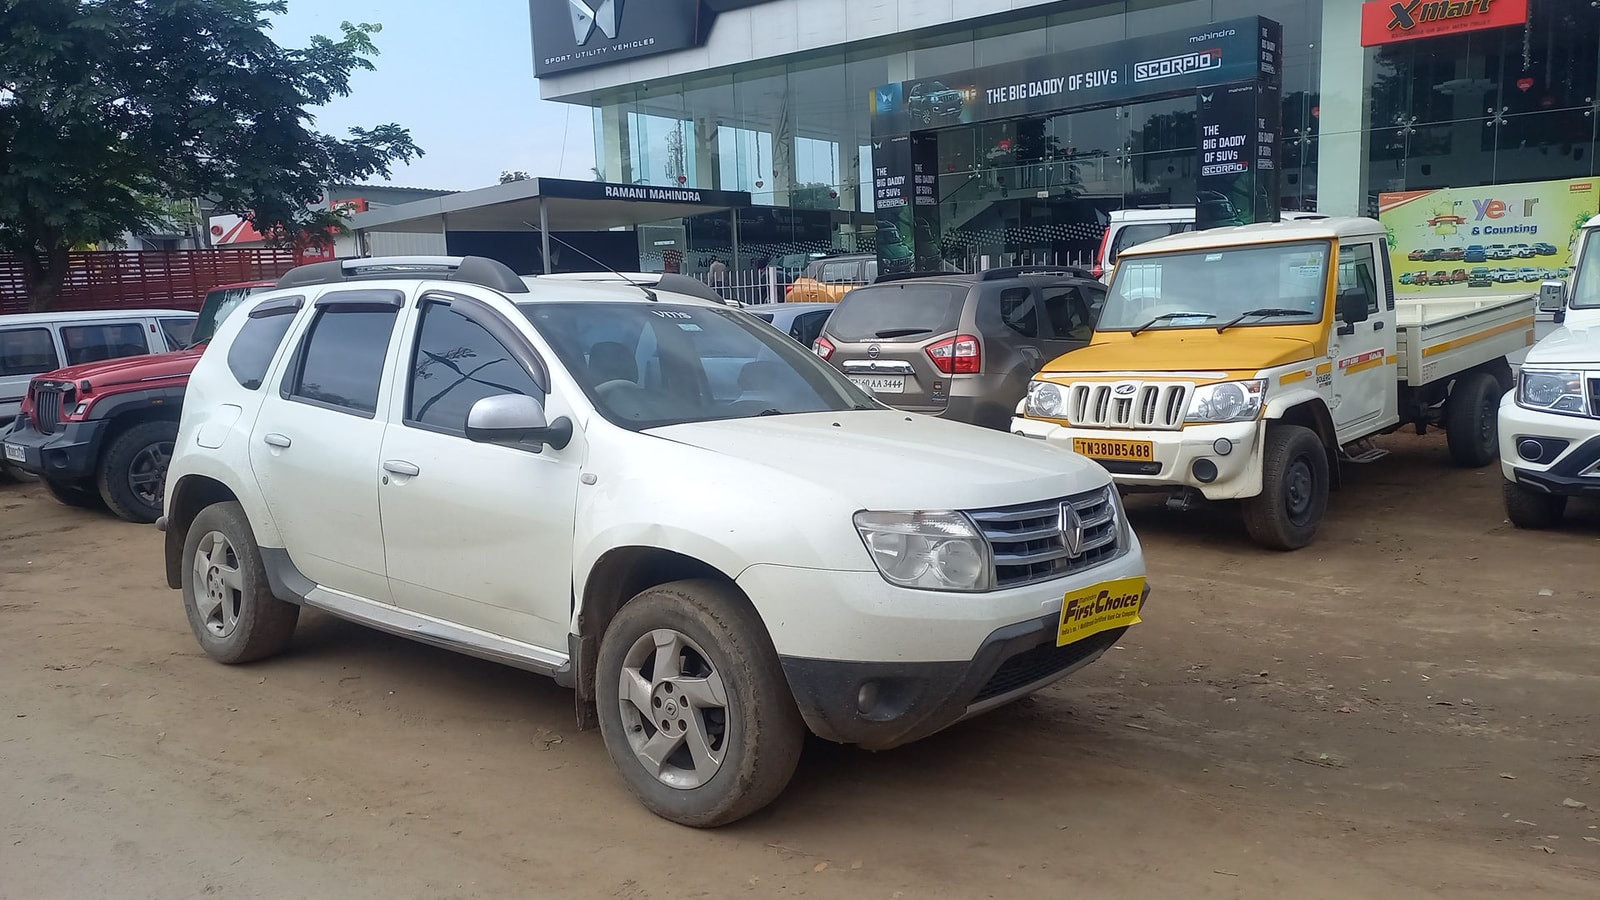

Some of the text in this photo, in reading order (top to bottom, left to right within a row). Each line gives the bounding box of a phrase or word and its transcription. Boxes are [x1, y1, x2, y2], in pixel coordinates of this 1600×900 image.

[1189, 28, 1236, 43] mahindra
[545, 38, 655, 65] SPORT UTILITY VEHICLES
[986, 70, 1118, 104] THE BIG DADDY OF SUVs
[1203, 125, 1219, 136] THE
[1203, 135, 1246, 150] BIG DADDY
[1205, 150, 1238, 163] OF SUVs
[876, 167, 887, 177] THE
[876, 176, 906, 188] BIG DADDY
[605, 186, 701, 202] RAMANI MAHINDRA
[877, 189, 884, 198] OF
[1471, 224, 1538, 236] & Counting
[1080, 441, 1150, 458] TN38DB5488
